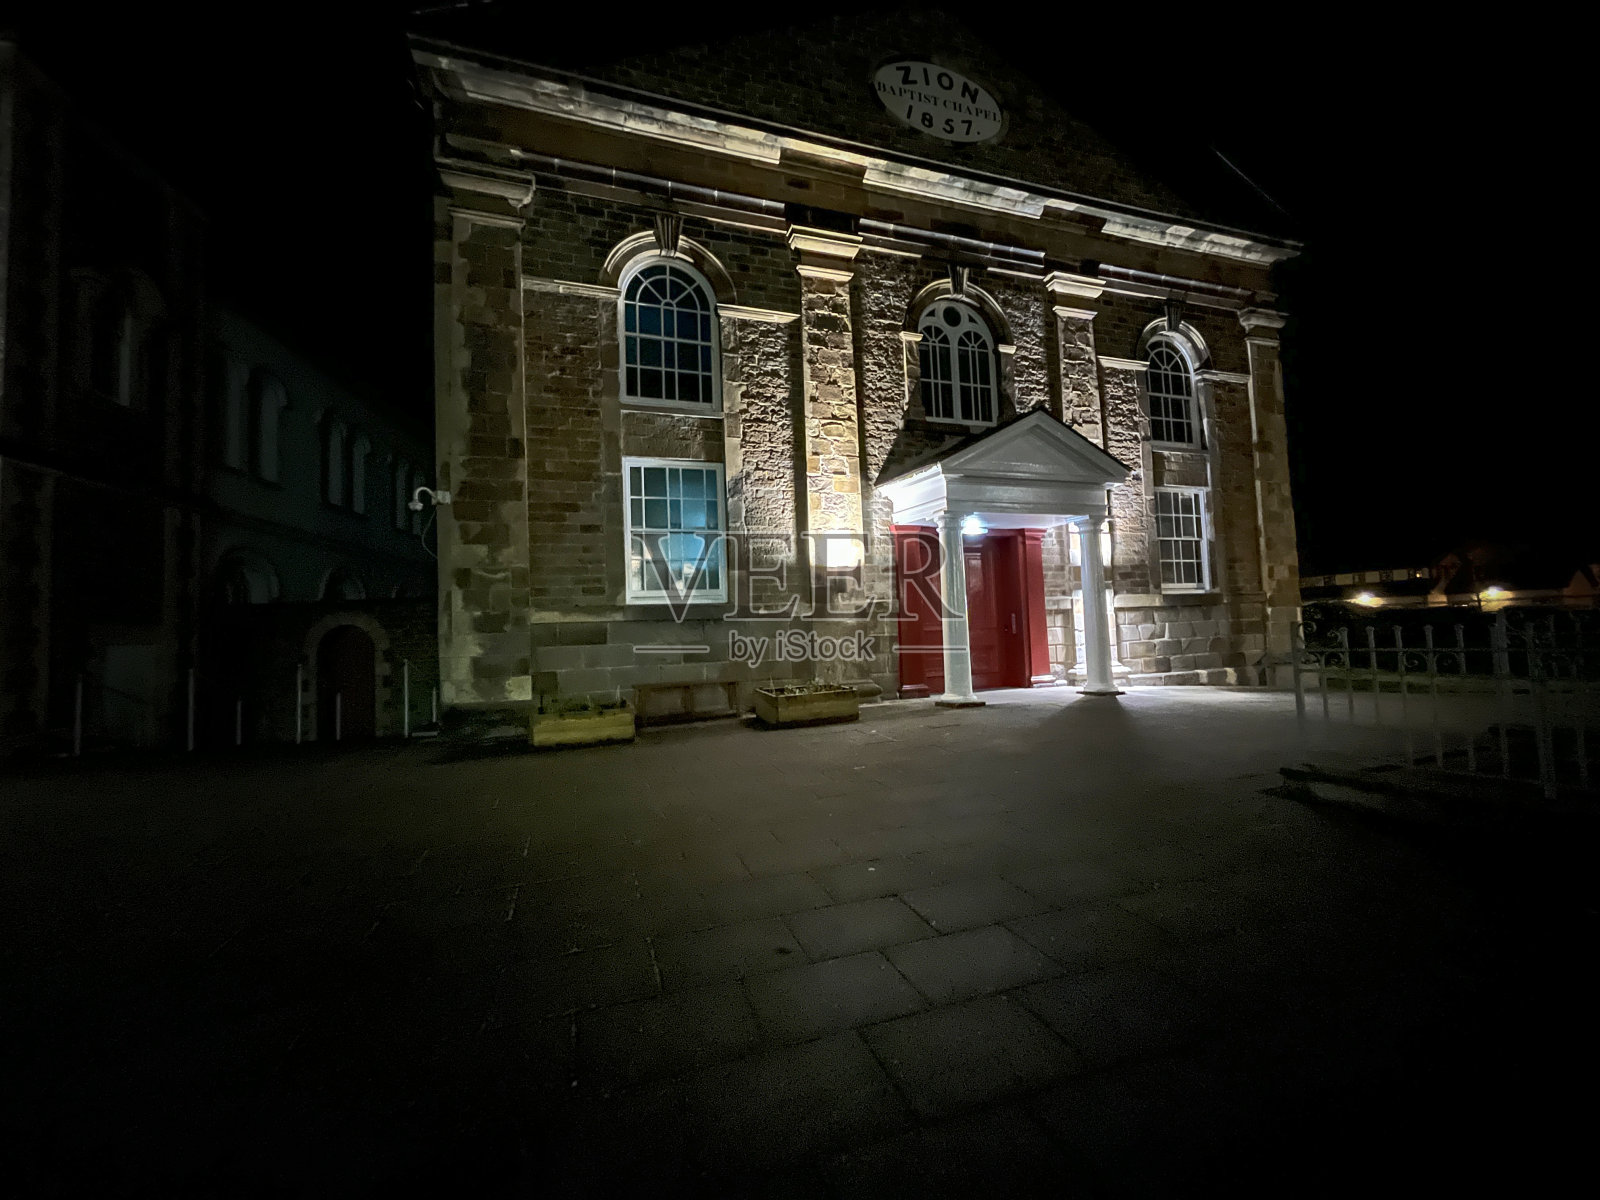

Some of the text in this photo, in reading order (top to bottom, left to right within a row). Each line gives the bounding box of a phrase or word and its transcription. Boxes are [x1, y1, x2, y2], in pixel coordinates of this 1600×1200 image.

[877, 81, 1000, 122] BAPTIST CHAPEL
[896, 66, 979, 104] ZION
